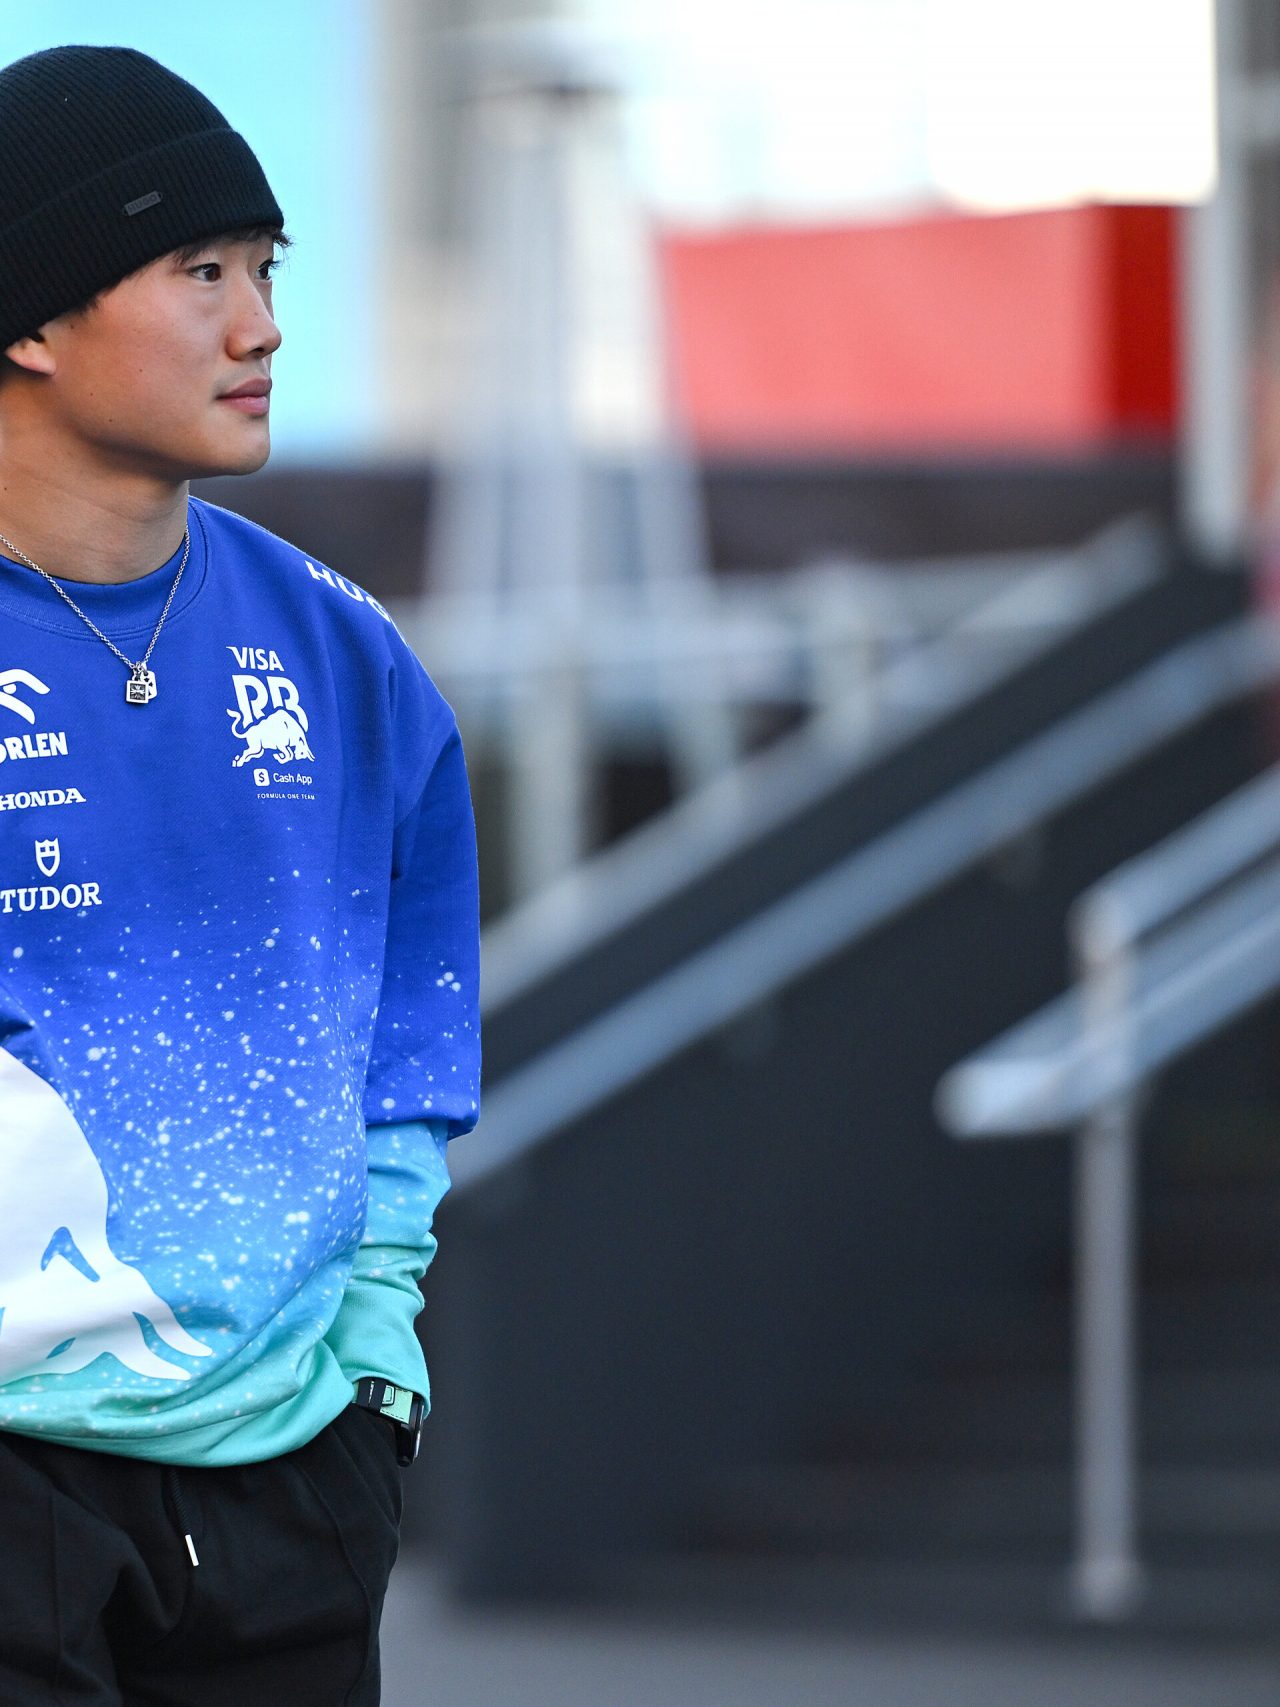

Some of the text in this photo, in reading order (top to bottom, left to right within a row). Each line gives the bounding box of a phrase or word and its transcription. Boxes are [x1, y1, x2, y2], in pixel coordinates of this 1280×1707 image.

[226, 646, 285, 672] VISA
[273, 772, 295, 783] Cash
[296, 773, 313, 786] App
[0, 881, 103, 914] TUDOR
